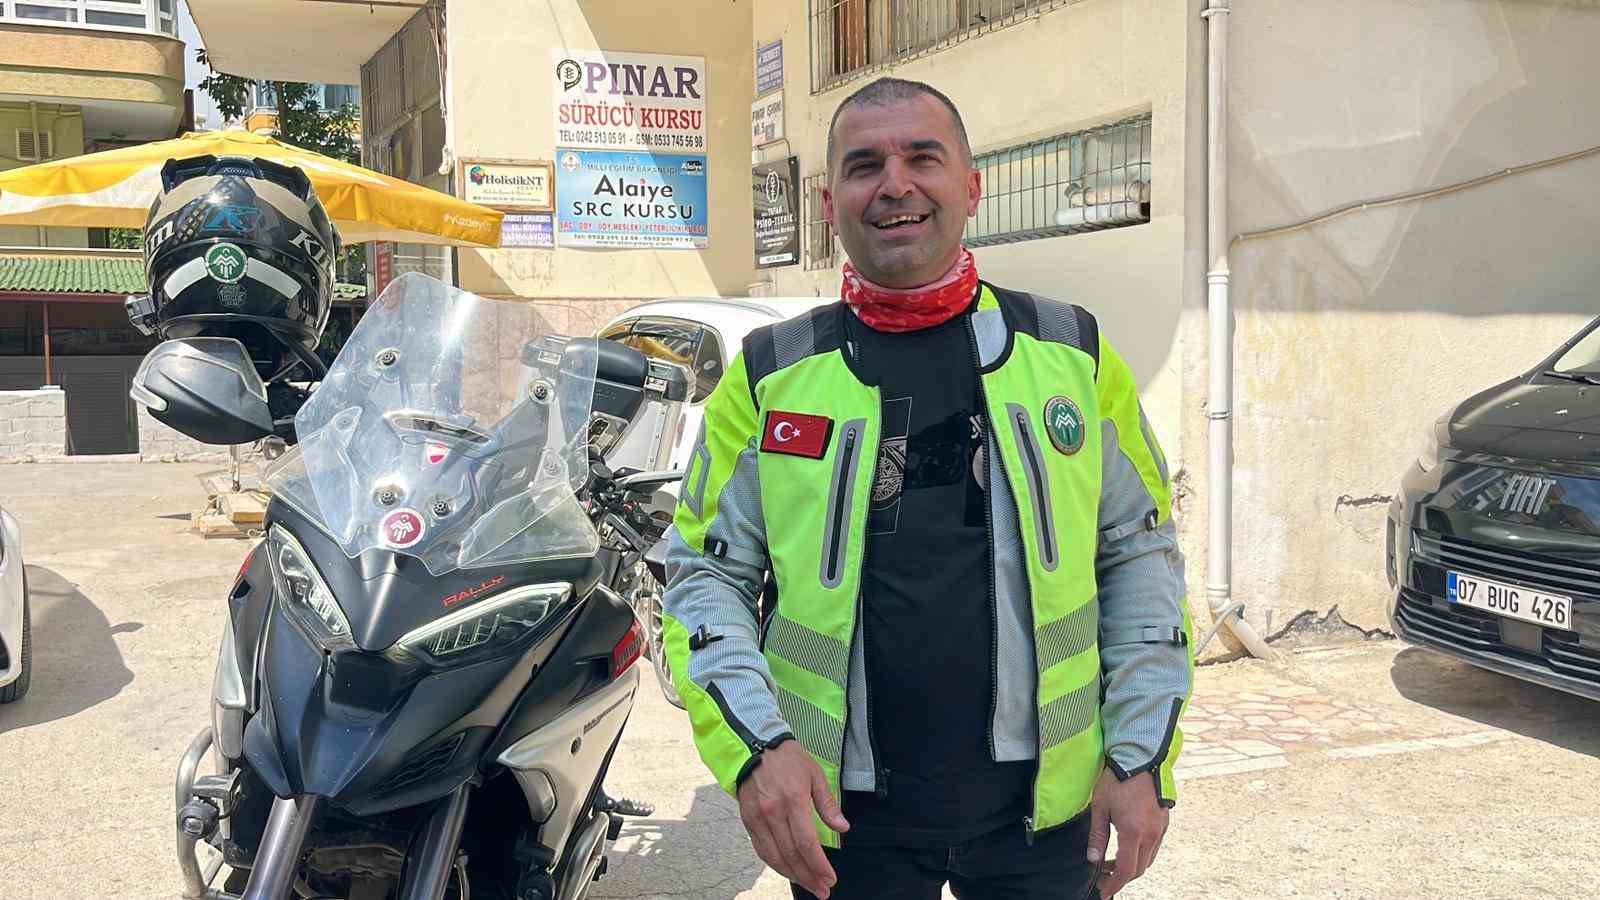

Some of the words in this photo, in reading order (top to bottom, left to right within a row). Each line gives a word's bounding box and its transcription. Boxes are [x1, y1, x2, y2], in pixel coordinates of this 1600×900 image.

[584, 62, 701, 99] PINAR
[559, 99, 634, 127] SÜRÜCÜ
[640, 107, 702, 130] KURSU
[560, 130, 575, 142] TEL:
[576, 131, 592, 143] 0242
[594, 132, 607, 144] 513
[608, 133, 617, 145] 05
[618, 133, 626, 145] 91
[636, 133, 653, 146] GSM:
[654, 134, 670, 147] 0533
[672, 135, 684, 147] 745
[685, 136, 694, 148] 56
[695, 136, 703, 148] 98
[594, 174, 673, 203] Alaiye
[573, 201, 612, 217] SRC
[624, 203, 692, 219] KURSU
[1500, 474, 1556, 515] FIAT
[443, 575, 504, 608] RALLY
[1458, 579, 1477, 603] 07
[1488, 586, 1519, 613] BUG
[1531, 596, 1566, 624] 426
